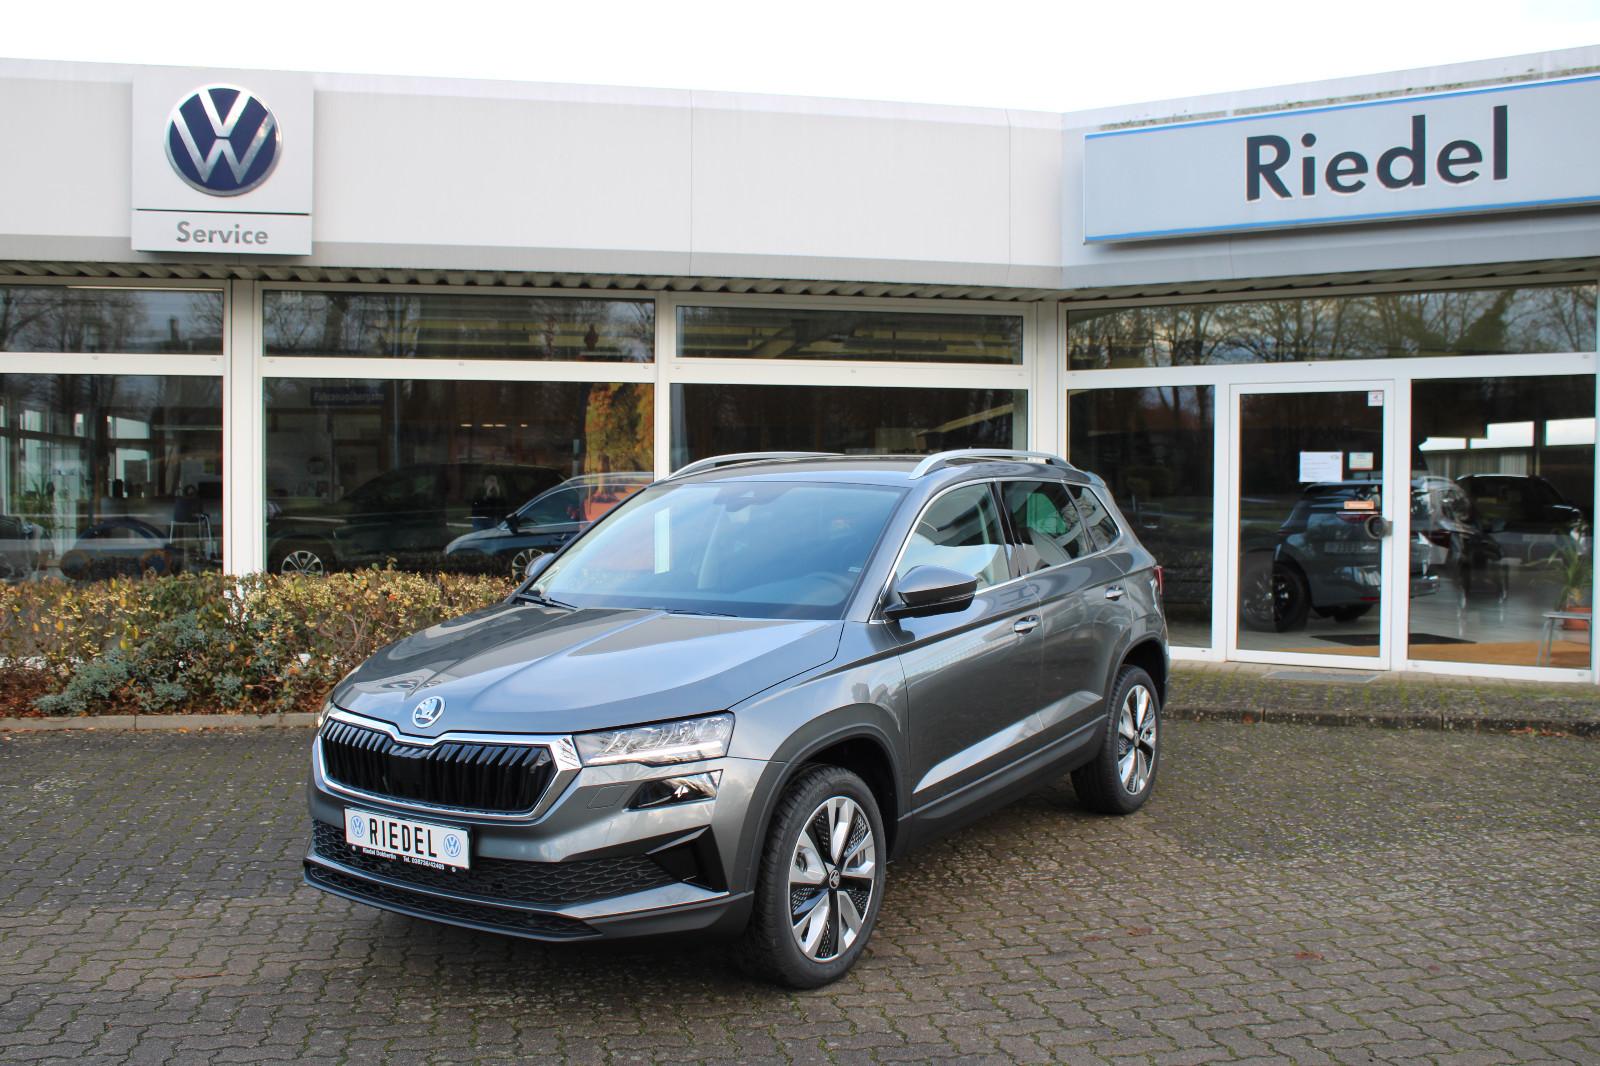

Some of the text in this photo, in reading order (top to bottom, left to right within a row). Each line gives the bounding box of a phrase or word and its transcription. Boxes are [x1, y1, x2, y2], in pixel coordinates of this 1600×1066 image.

[1246, 105, 1508, 201] Riedel
[176, 221, 269, 244] Service
[369, 818, 437, 858] RIEDEL
